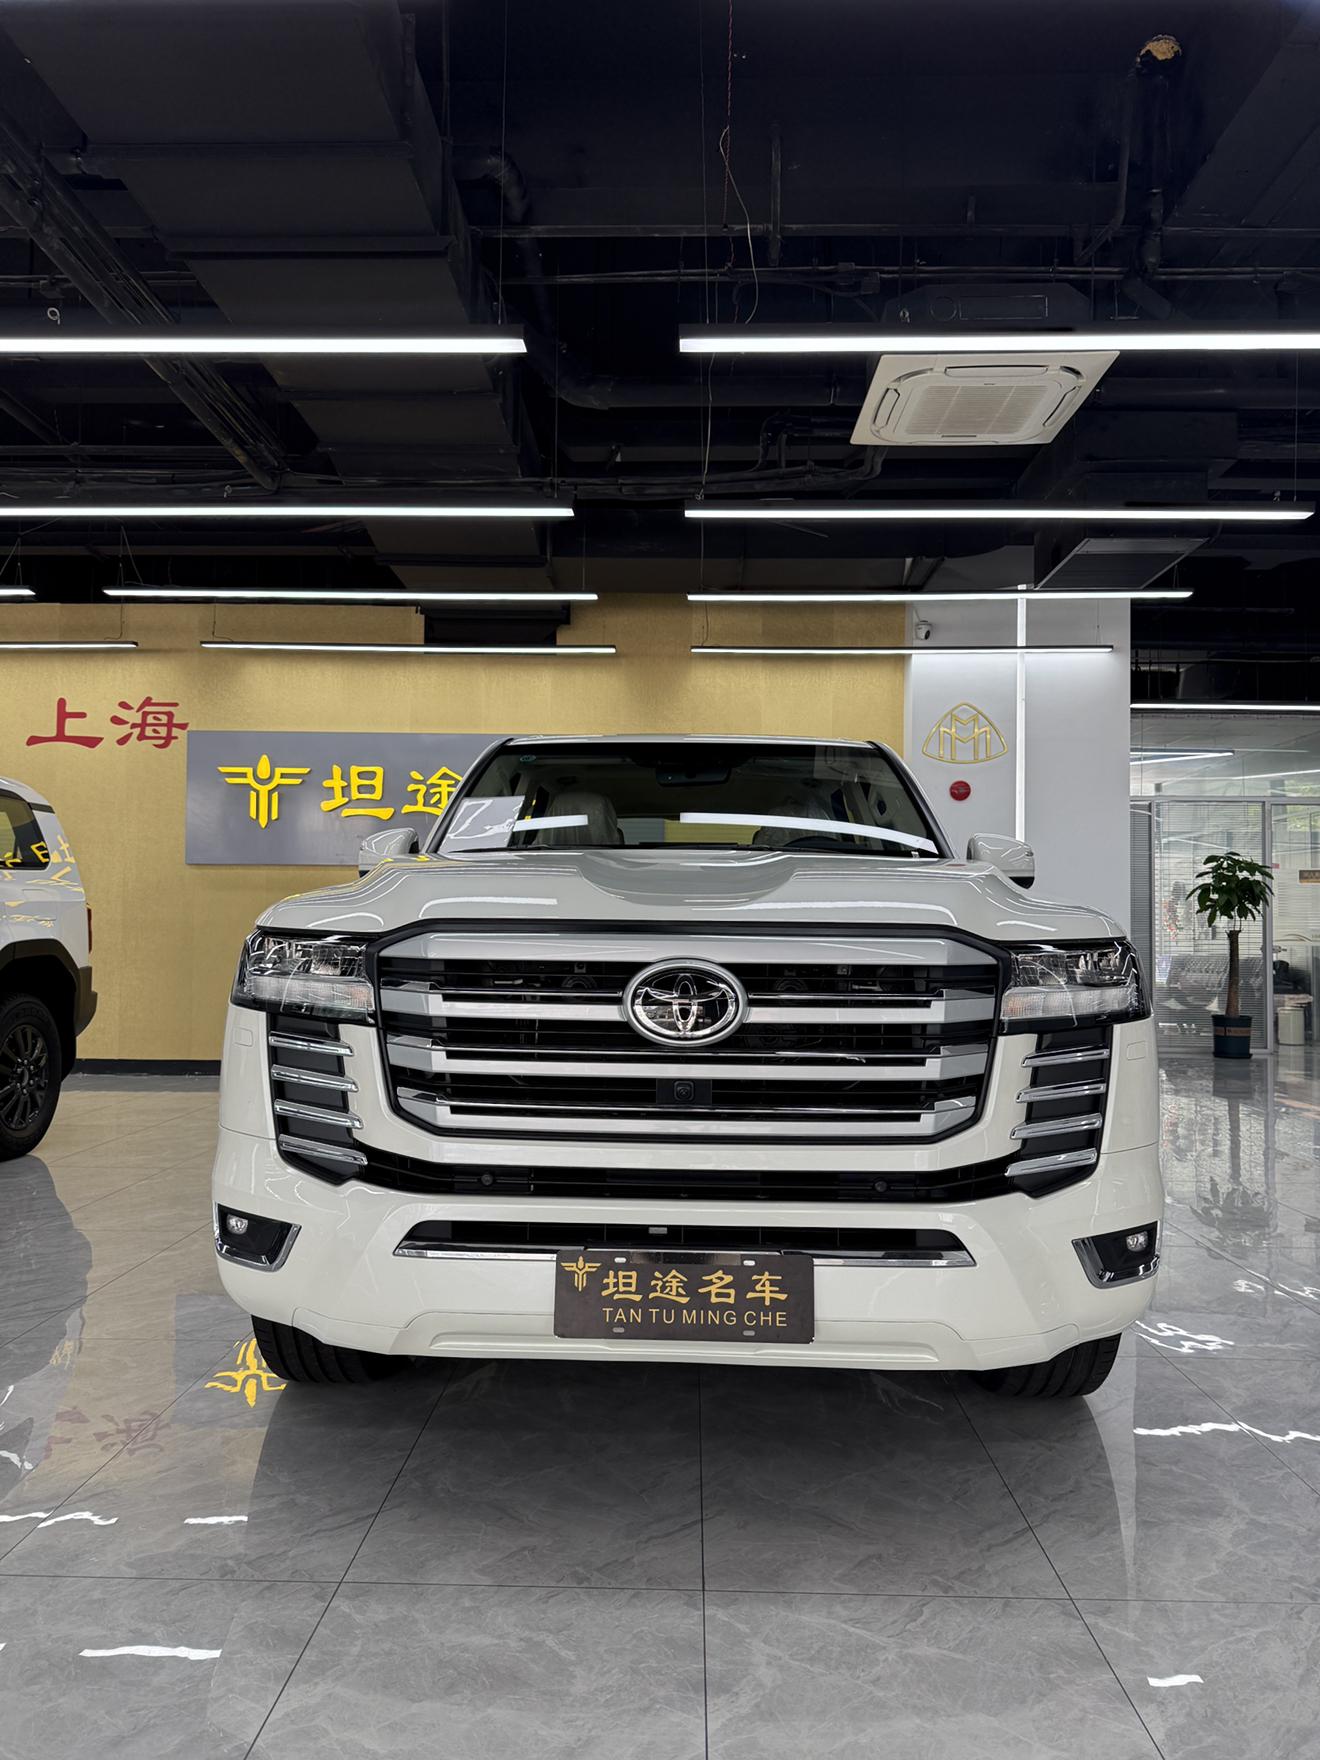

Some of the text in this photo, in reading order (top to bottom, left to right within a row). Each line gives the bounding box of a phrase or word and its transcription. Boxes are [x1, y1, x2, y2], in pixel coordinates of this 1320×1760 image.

[25, 696, 190, 750] 上海
[320, 764, 463, 821] 坦途
[601, 1268, 789, 1307] 坦途名车
[602, 1307, 788, 1327] TAN TU MING CHE
